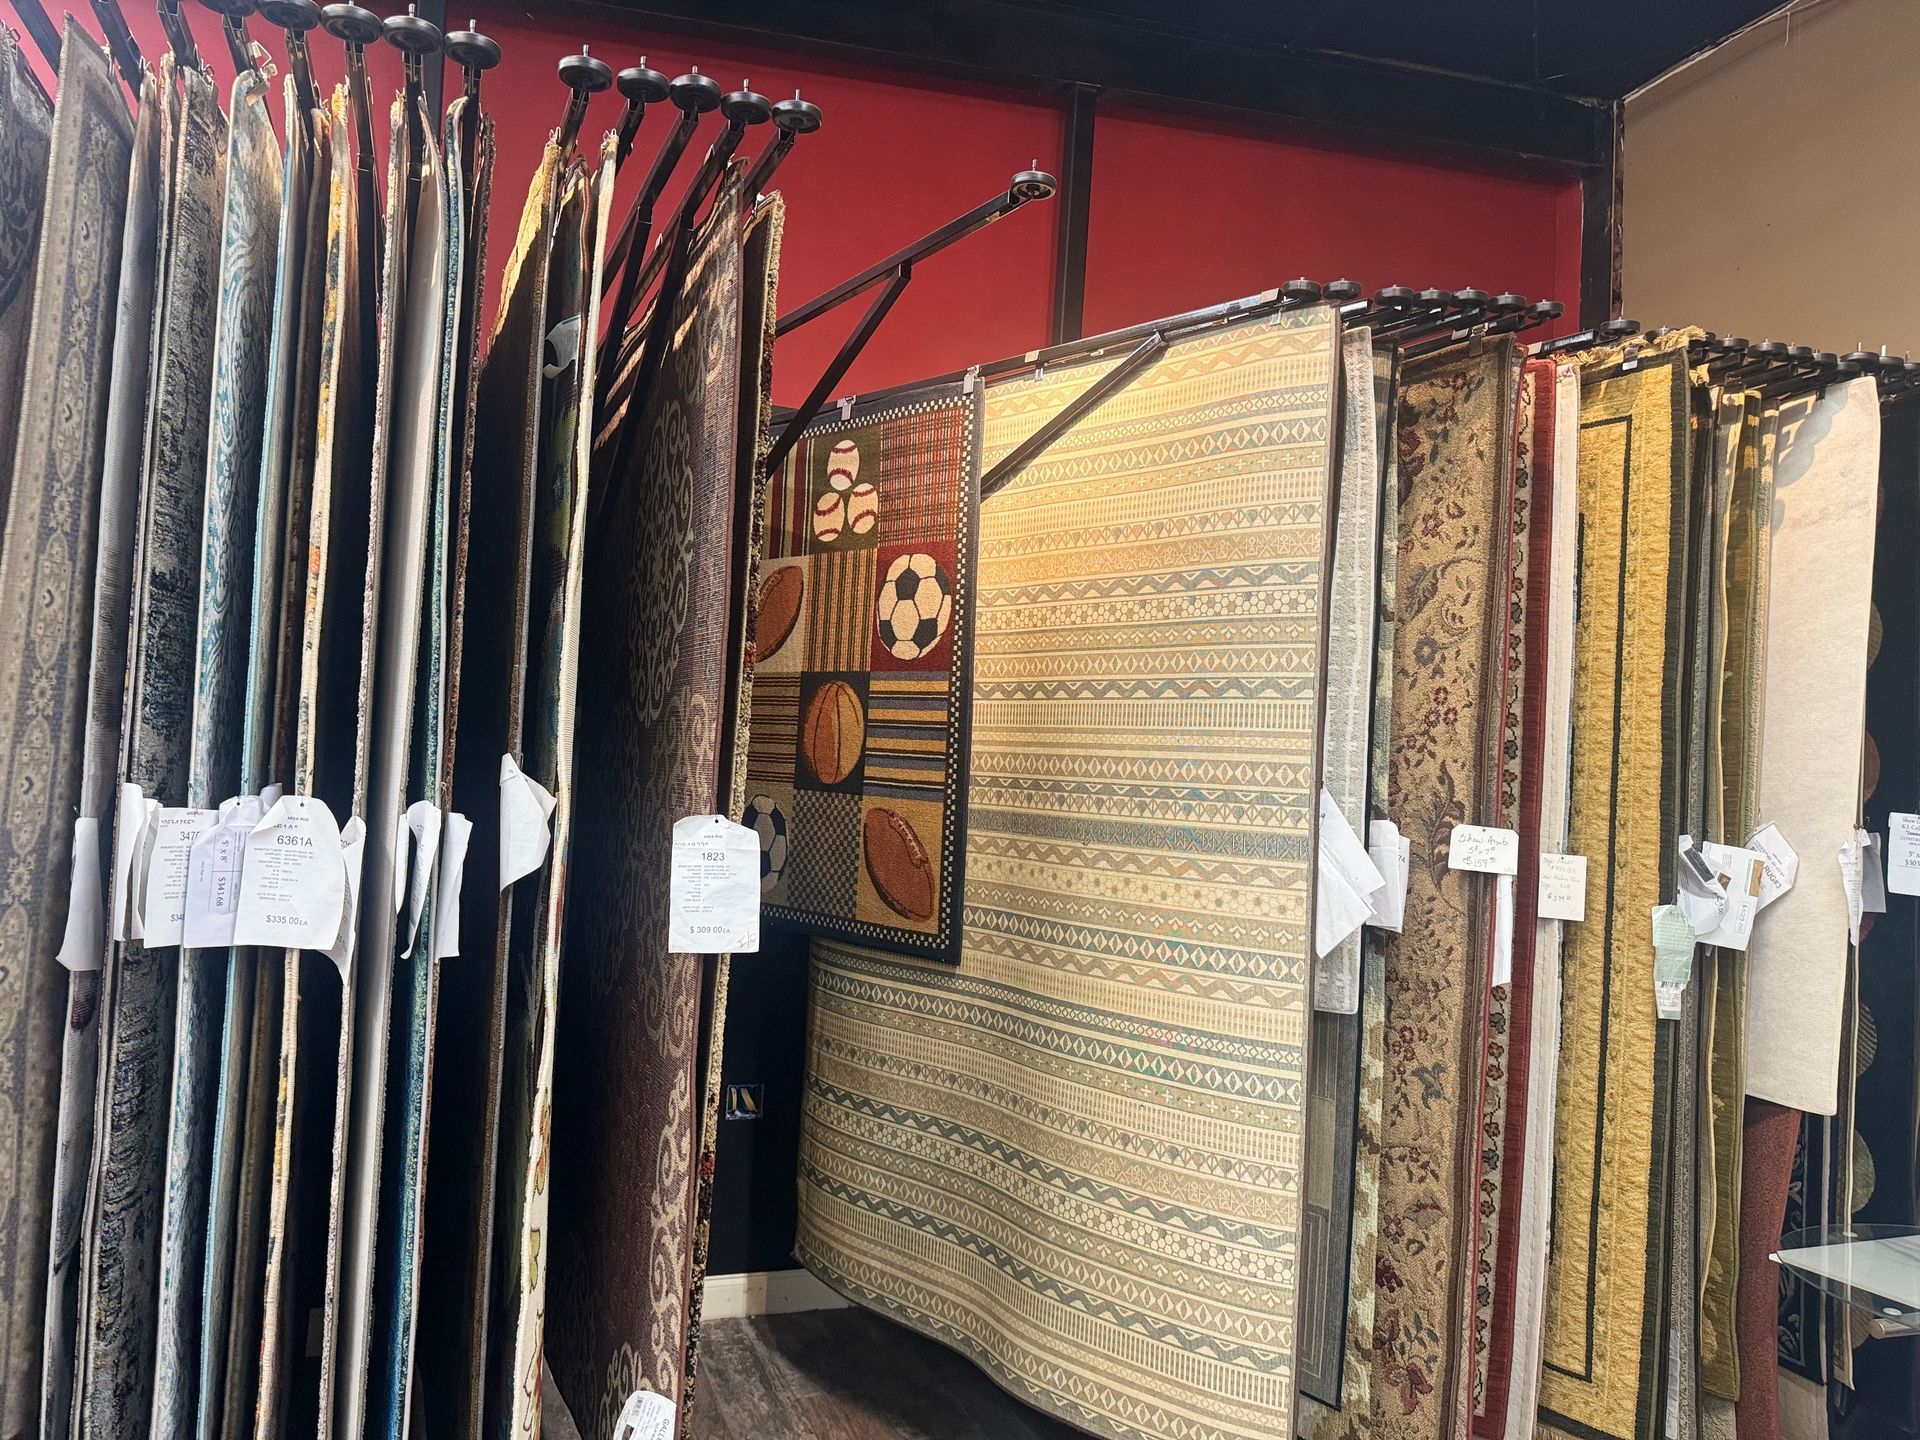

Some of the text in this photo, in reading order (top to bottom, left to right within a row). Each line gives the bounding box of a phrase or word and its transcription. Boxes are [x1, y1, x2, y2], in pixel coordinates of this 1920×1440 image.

[277, 834, 313, 847] 6361A
[701, 852, 726, 862] 1823
[1763, 865, 1782, 889] RUG#3
